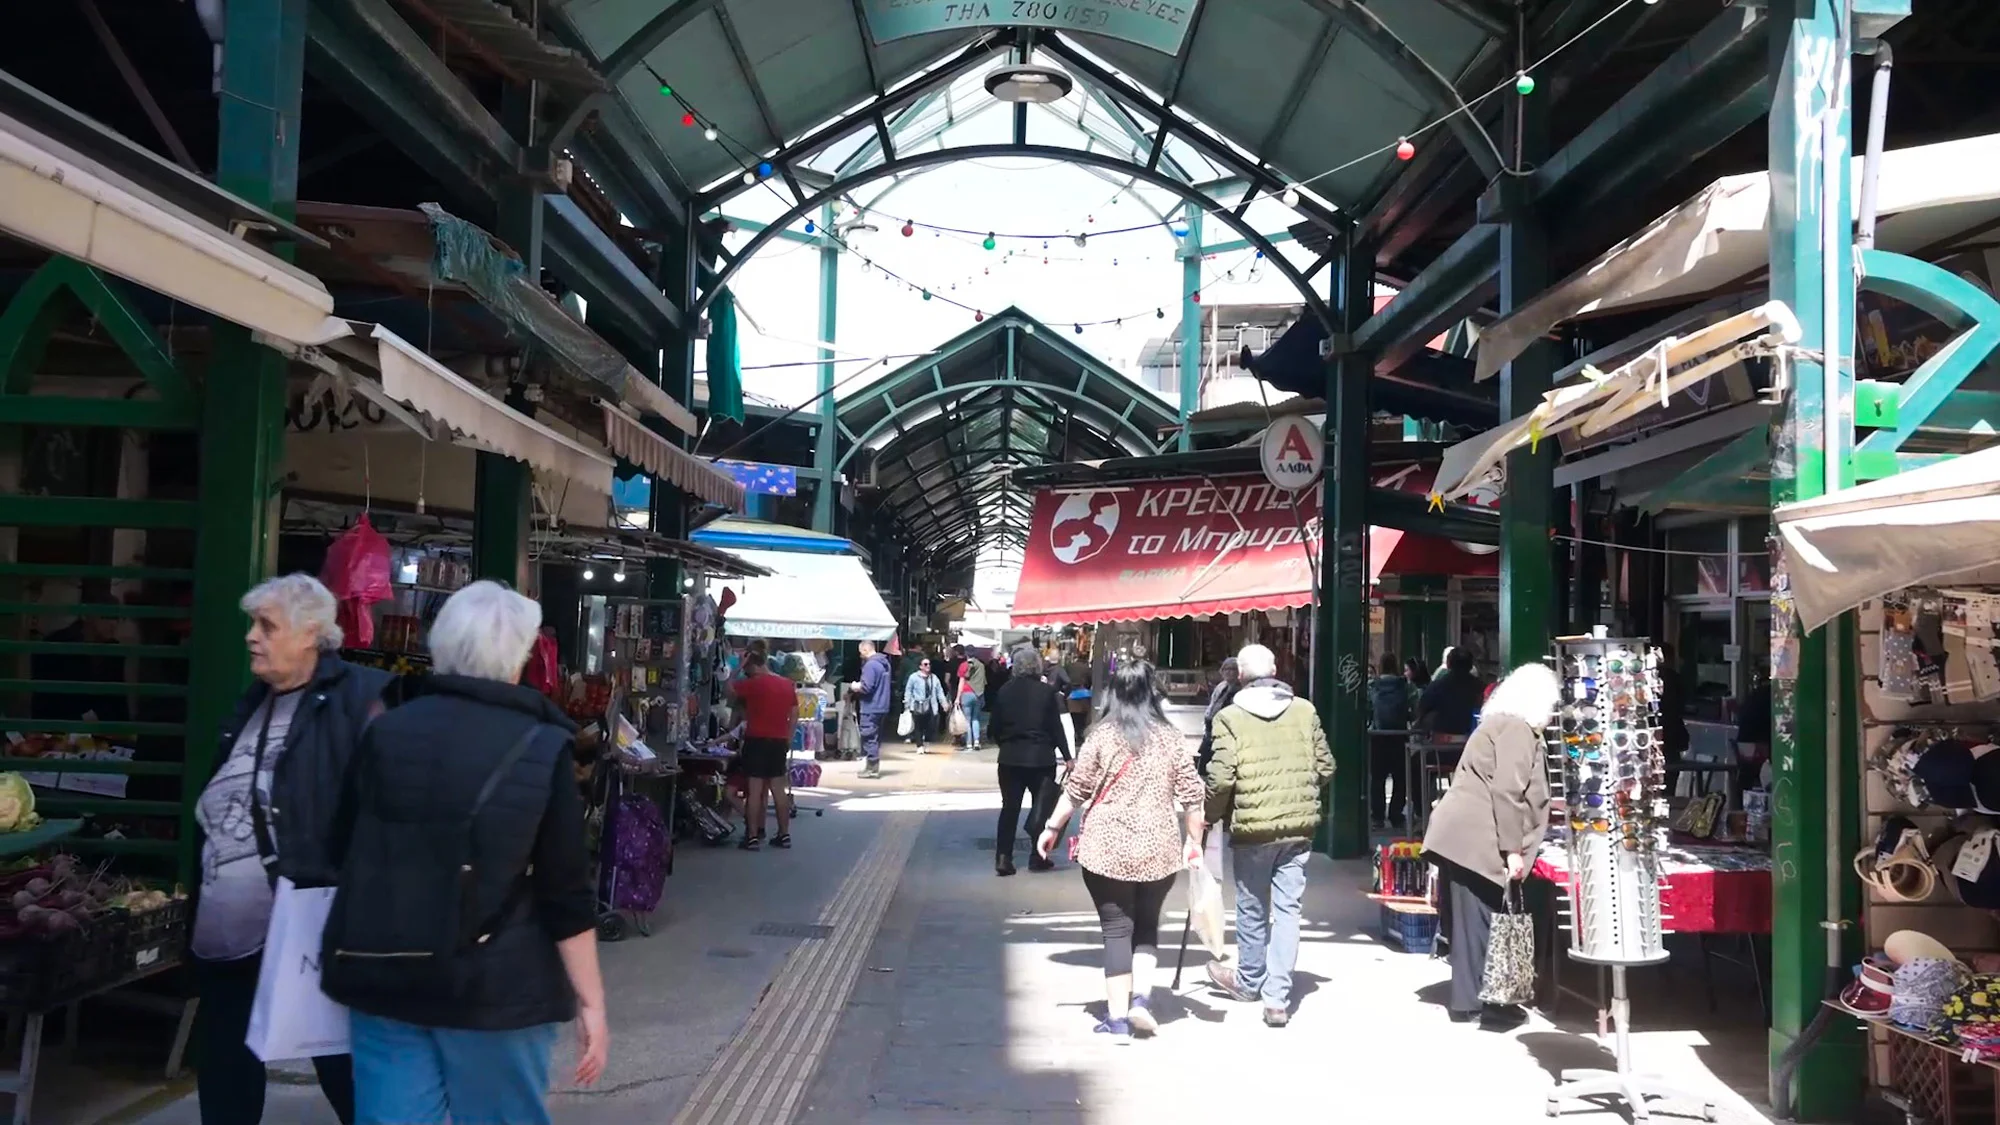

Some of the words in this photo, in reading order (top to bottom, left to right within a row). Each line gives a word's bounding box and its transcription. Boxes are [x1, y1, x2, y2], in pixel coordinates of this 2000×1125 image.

[944, 2, 990, 22] ΤΗΛ
[1011, 0, 1058, 20] 780
[1276, 462, 1313, 474] ΑΛΦΑ
